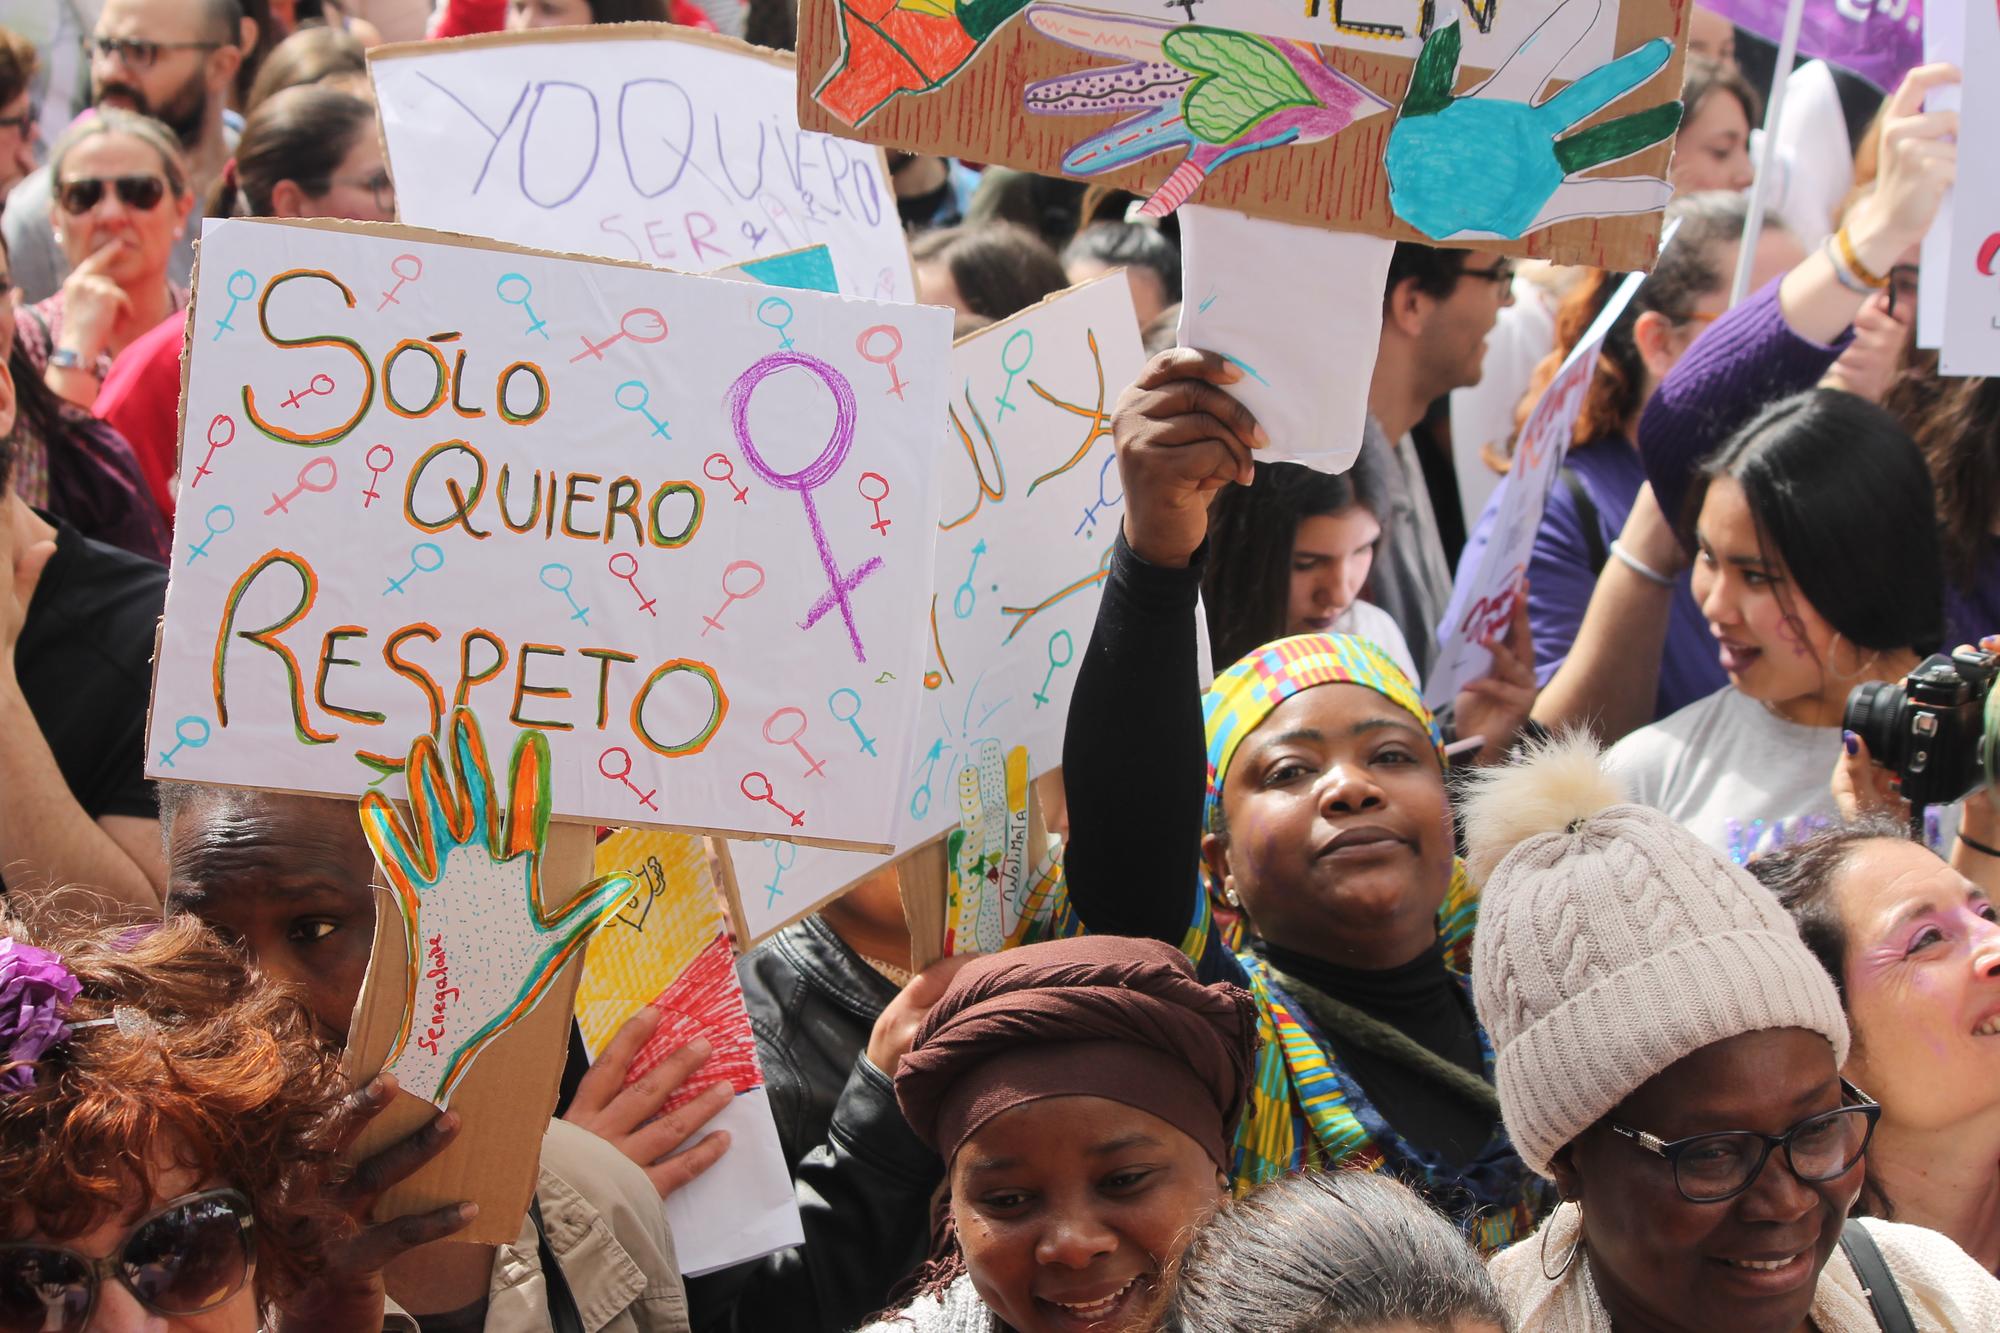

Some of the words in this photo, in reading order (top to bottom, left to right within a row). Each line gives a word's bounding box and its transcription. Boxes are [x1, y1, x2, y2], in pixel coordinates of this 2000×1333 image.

[415, 71, 601, 209] YO
[600, 210, 732, 264] SER
[404, 439, 706, 550] QUIERO
[212, 547, 730, 773] RESPETO
